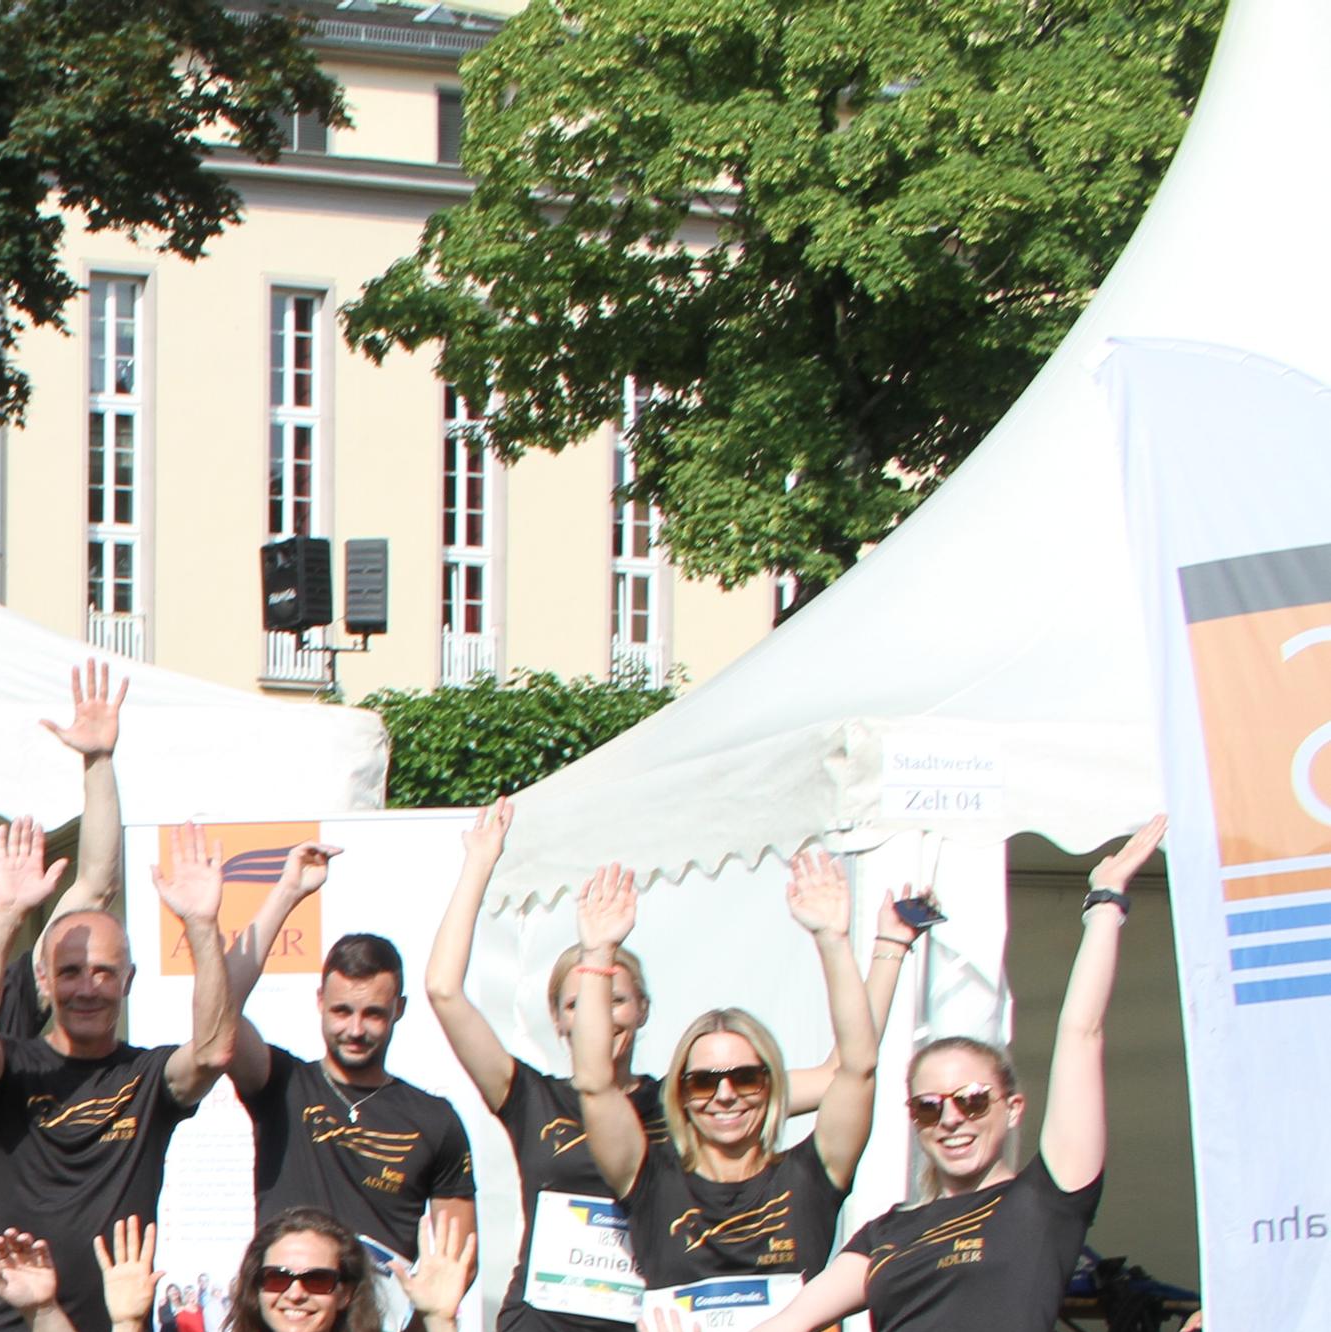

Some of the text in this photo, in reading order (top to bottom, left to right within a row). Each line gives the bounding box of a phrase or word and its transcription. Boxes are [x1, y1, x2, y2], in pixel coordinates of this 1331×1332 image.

[893, 753, 993, 771] Stadtwerke
[905, 789, 981, 810] Zelt 04
[936, 1250, 986, 1270] ADLER
